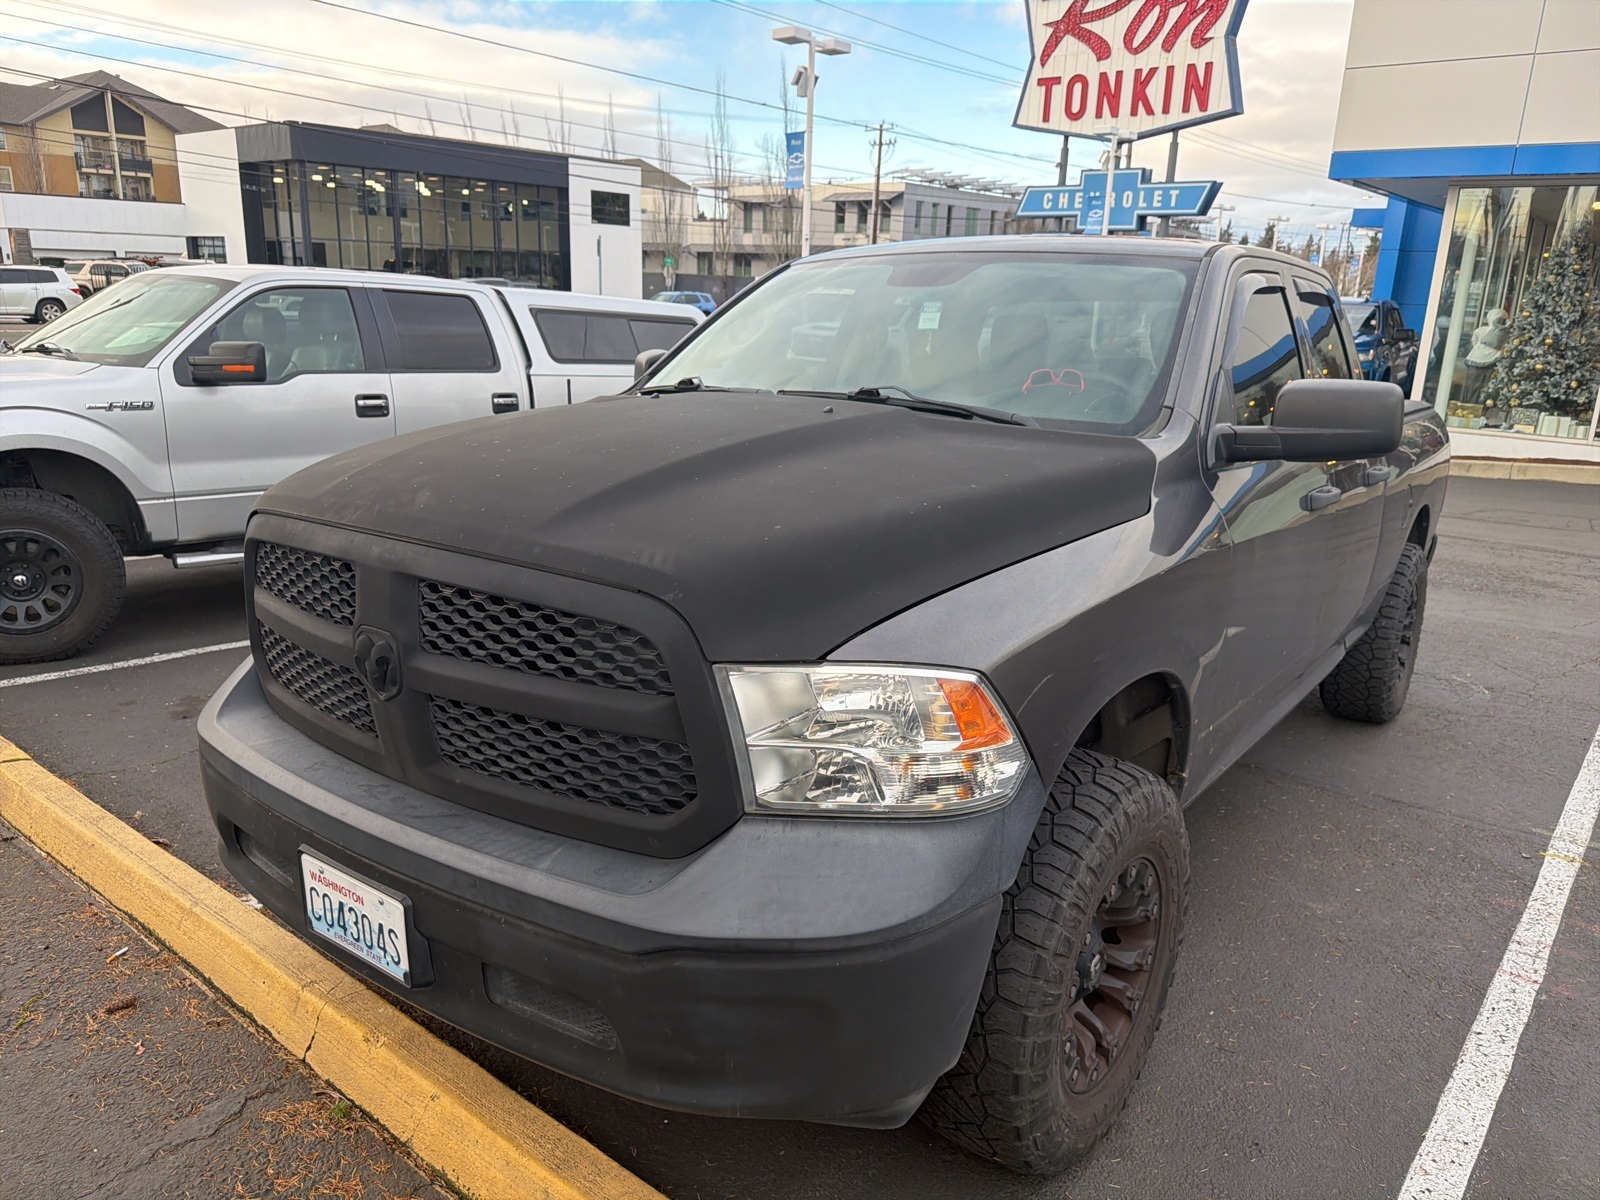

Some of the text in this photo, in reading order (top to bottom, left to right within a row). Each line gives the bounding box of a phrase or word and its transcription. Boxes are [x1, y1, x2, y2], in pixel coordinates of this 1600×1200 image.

[1040, 0, 1228, 67] Ron
[1037, 62, 1214, 123] TONKIN
[1043, 189, 1180, 209] CHEROLET
[309, 870, 364, 906] WASHINGTON
[310, 886, 401, 966] C04304S
[334, 931, 383, 964] EVERGREEN STATE
